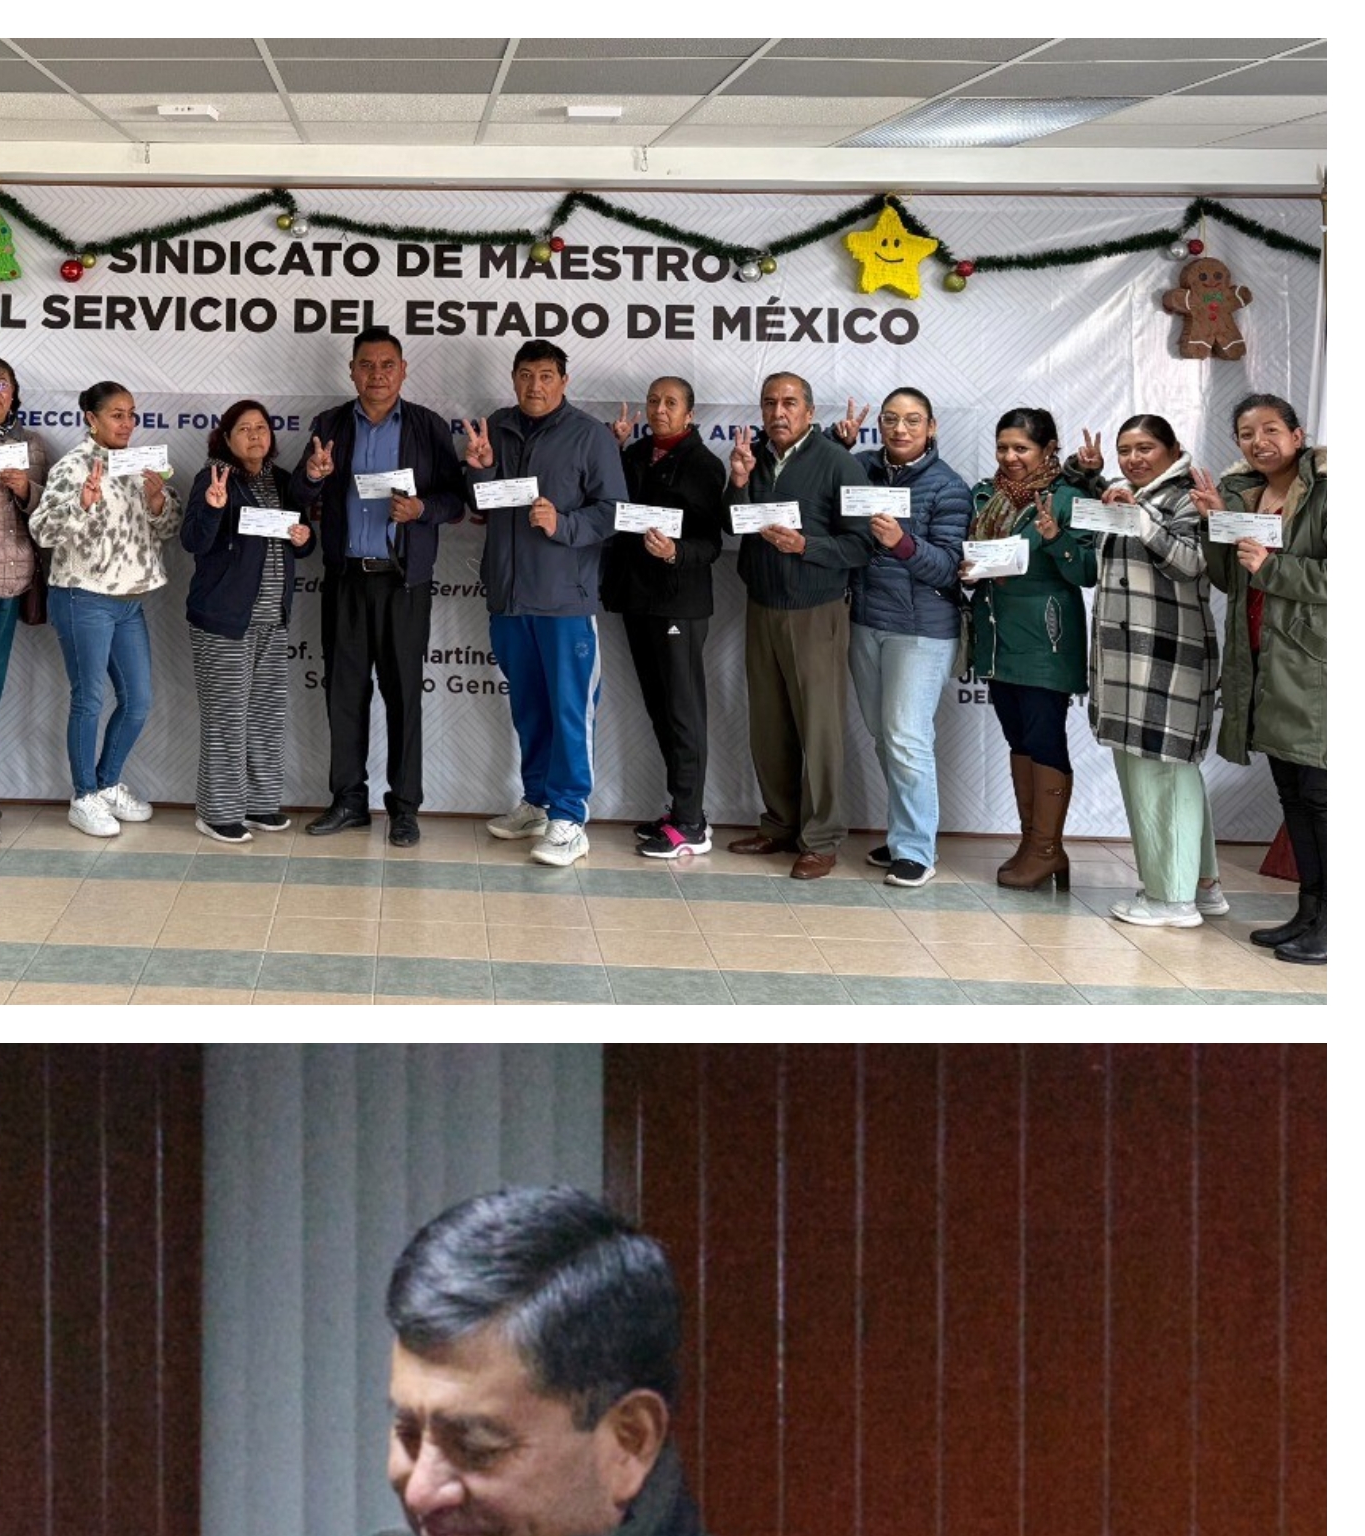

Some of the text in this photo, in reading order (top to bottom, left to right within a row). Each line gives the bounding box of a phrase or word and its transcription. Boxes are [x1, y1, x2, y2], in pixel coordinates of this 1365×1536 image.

[107, 239, 749, 283] SINDICATO DE MAESTRO
[40, 294, 278, 333] SERVICIO
[293, 299, 390, 334] DEL
[405, 300, 610, 339] ESTADO
[626, 305, 695, 341] DE
[712, 296, 920, 345] MÉXICO
[16, 411, 81, 426] RECCI
[424, 646, 499, 666] artíne
[447, 675, 511, 695] Gene
